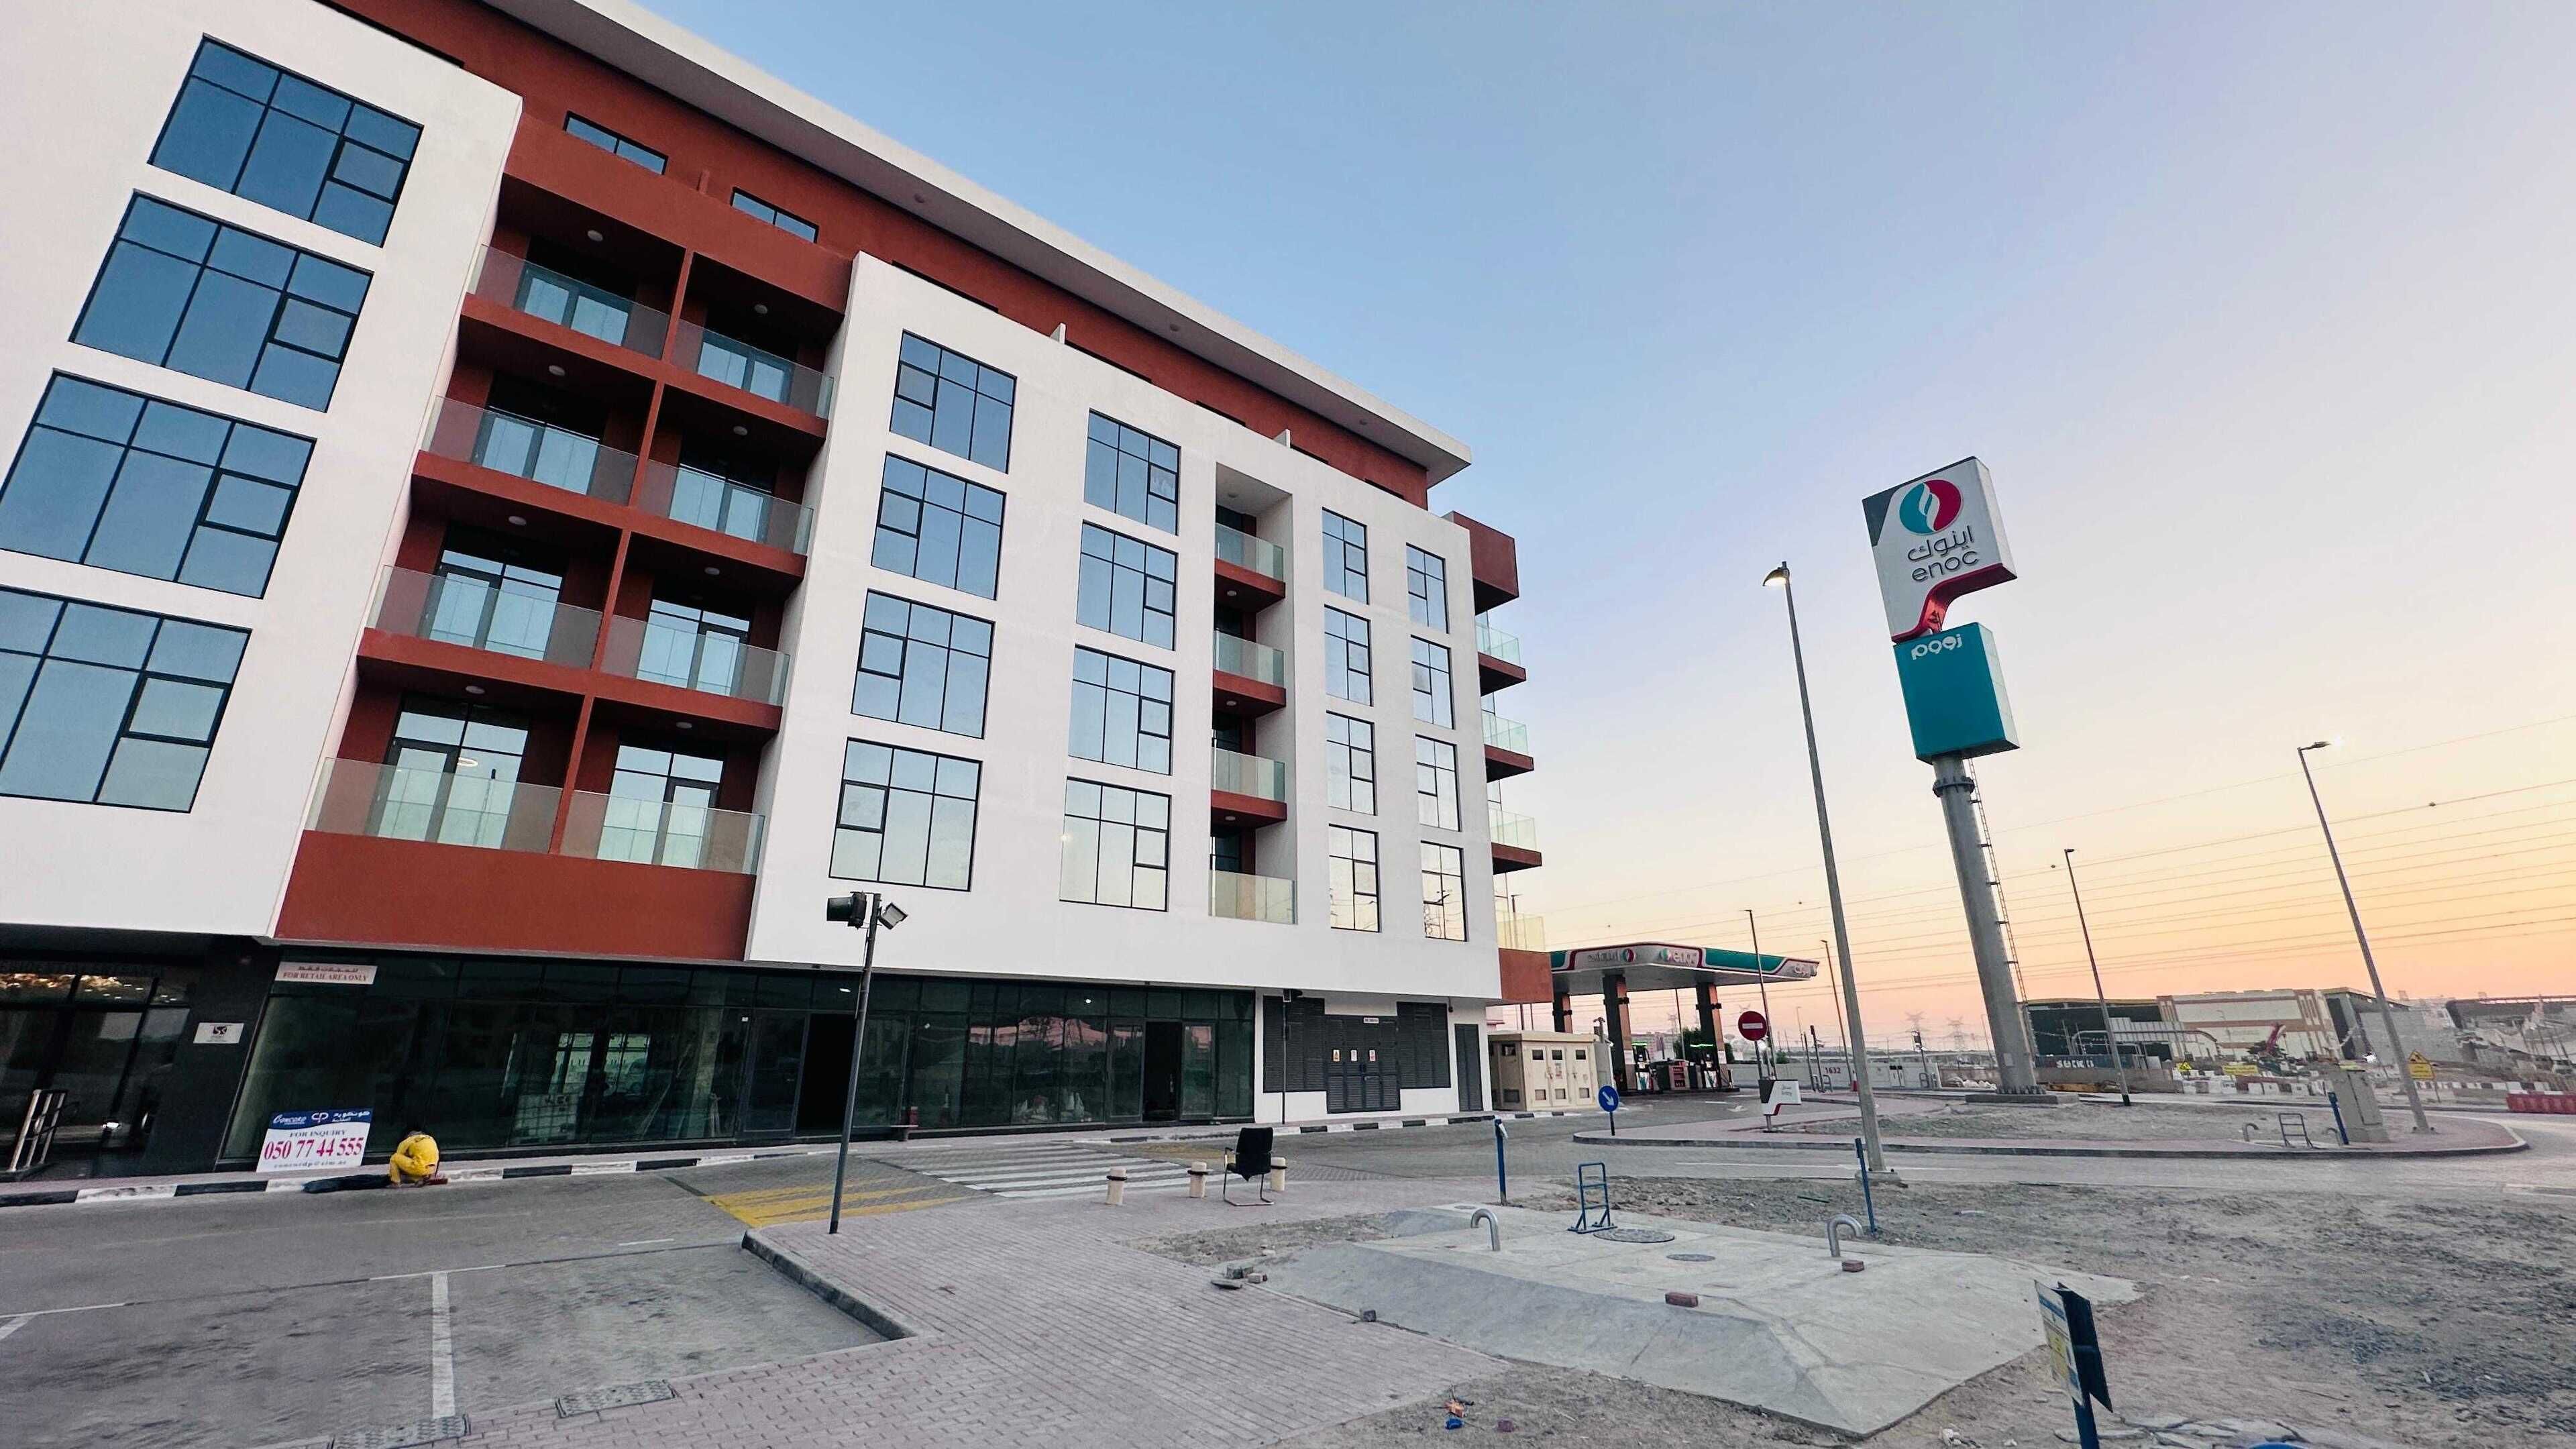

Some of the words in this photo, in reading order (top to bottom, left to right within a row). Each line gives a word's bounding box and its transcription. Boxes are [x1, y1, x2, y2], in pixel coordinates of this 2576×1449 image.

[1912, 550, 1979, 582] enoc
[347, 973, 368, 982] ONLY
[310, 1130, 346, 1138] INQUIRY
[264, 1141, 292, 1160] 050
[296, 1139, 315, 1158] 77
[316, 1138, 335, 1157] 44
[337, 1137, 364, 1157] 555
